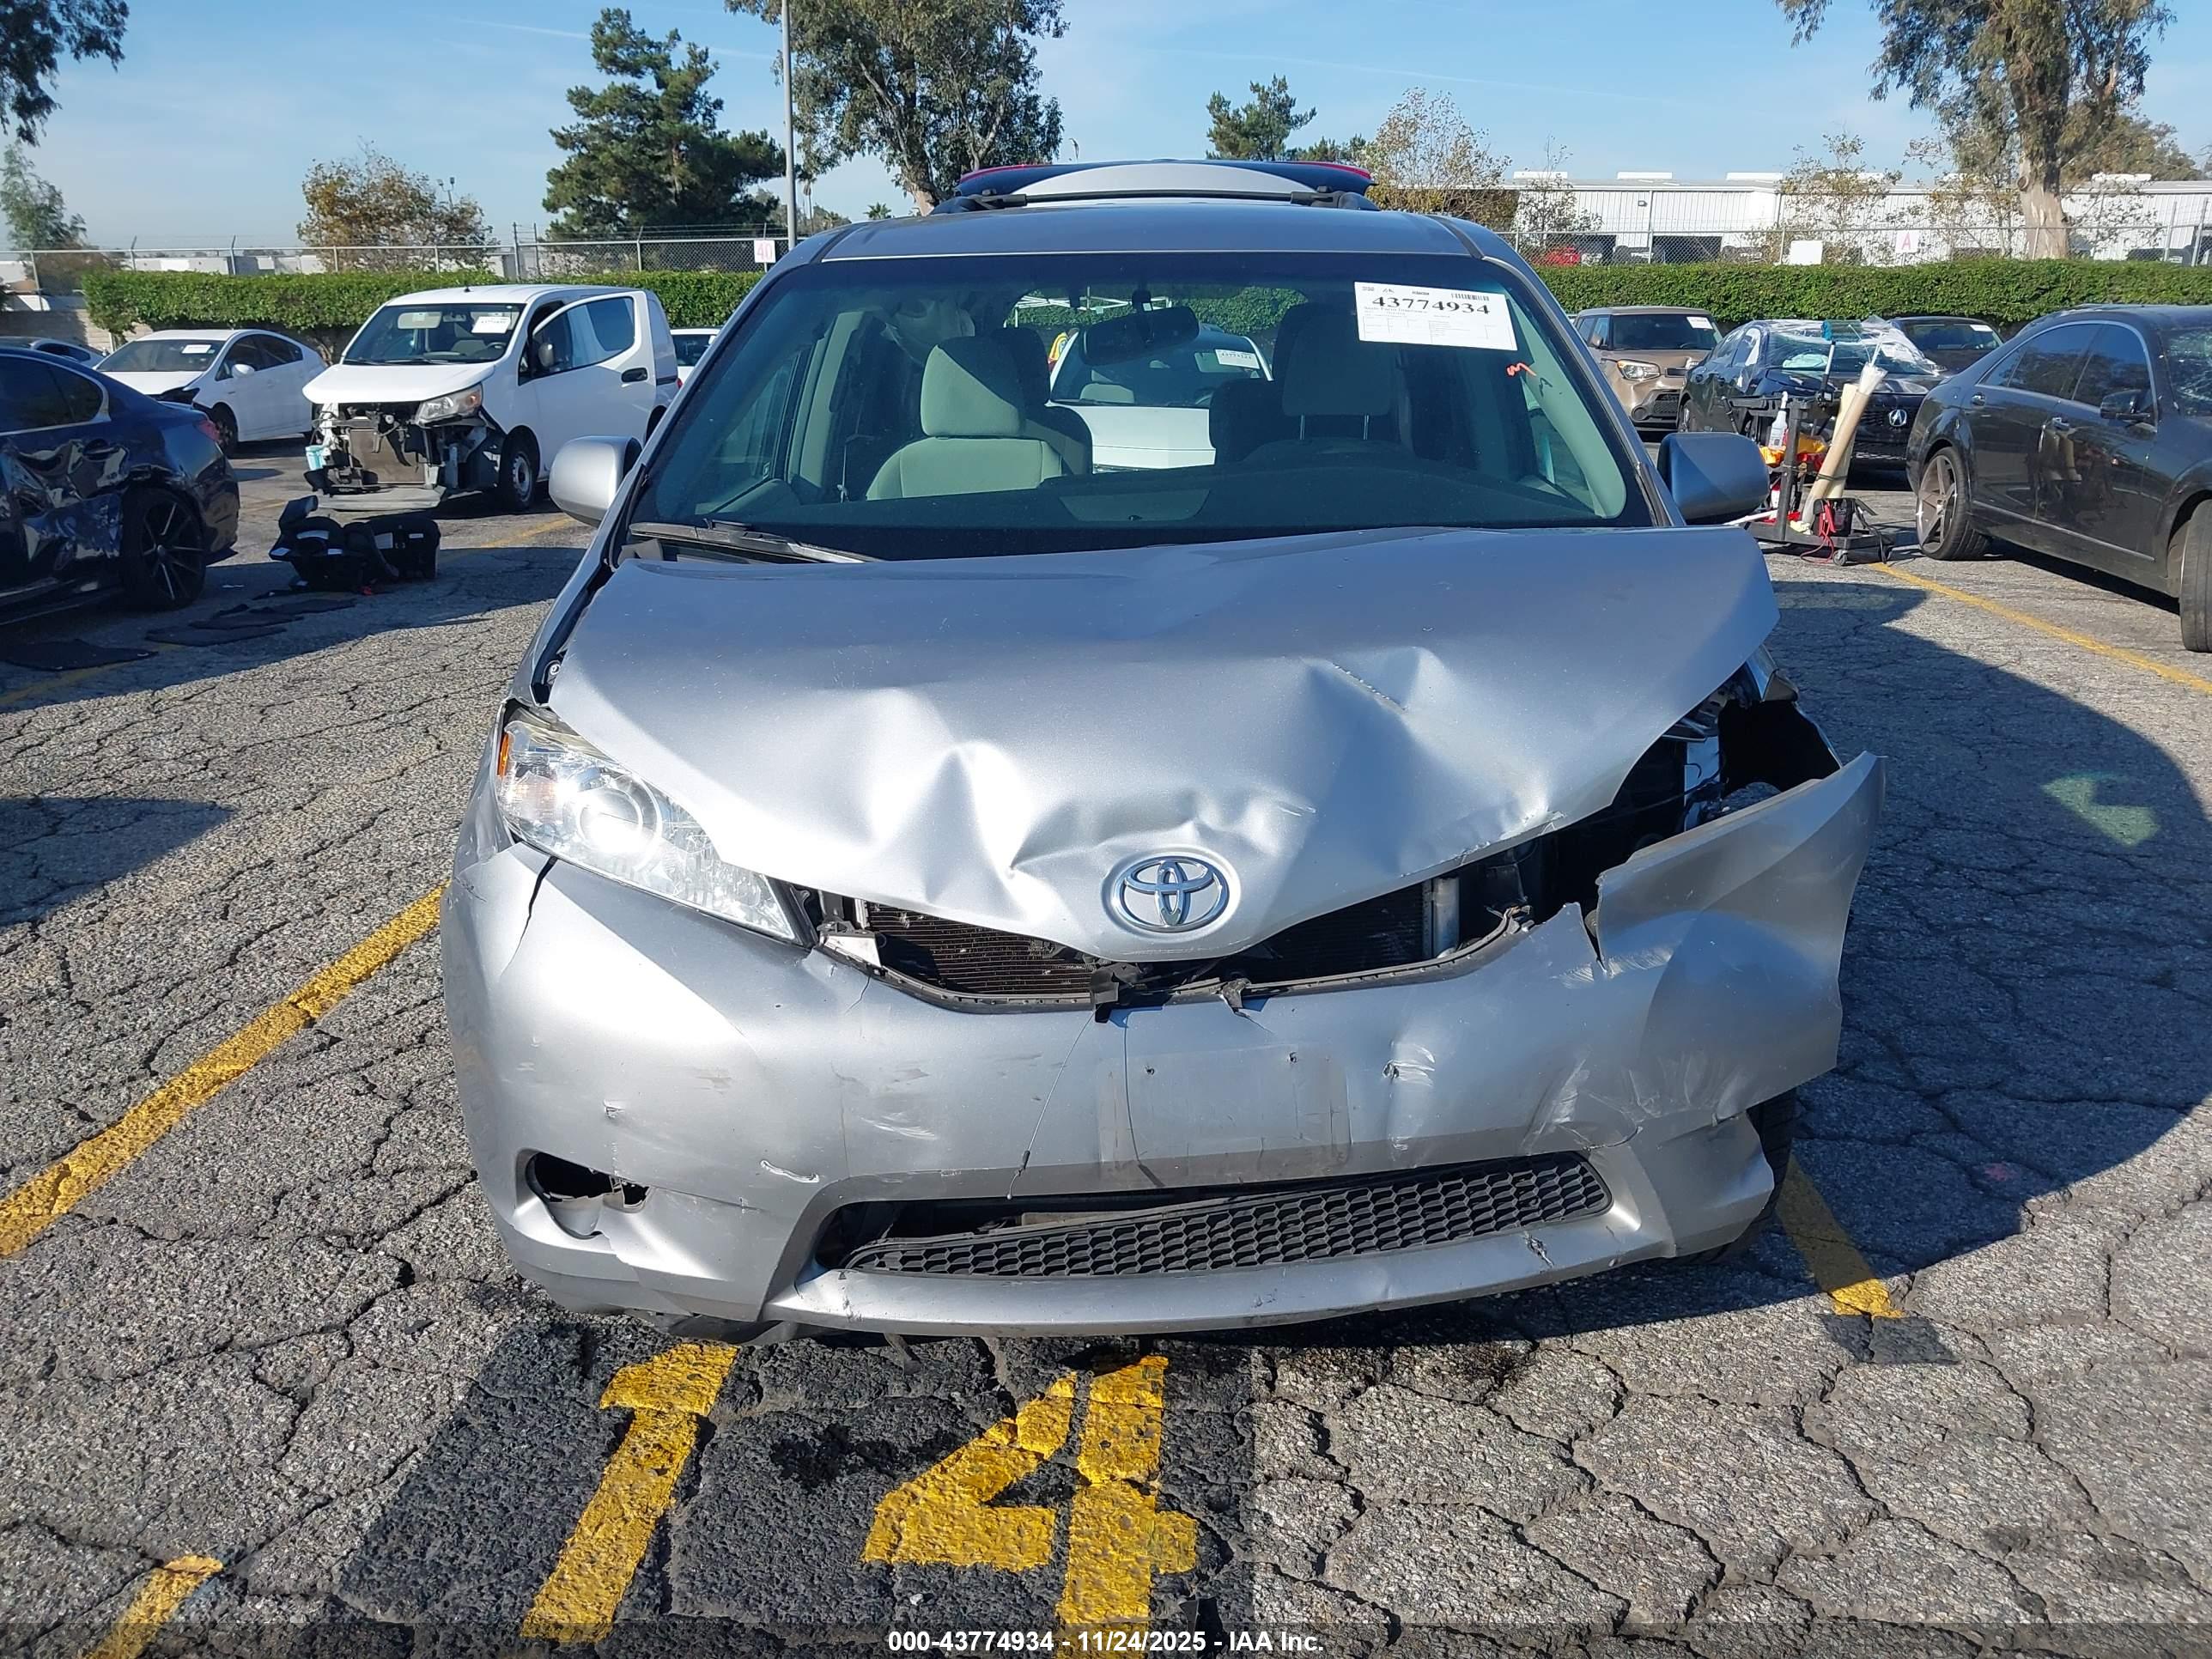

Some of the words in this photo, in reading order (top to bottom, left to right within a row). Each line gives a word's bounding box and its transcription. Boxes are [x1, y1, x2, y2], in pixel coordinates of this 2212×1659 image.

[757, 242, 773, 261] 40
[1901, 233, 1911, 251] A
[1371, 295, 1491, 315] 43774934
